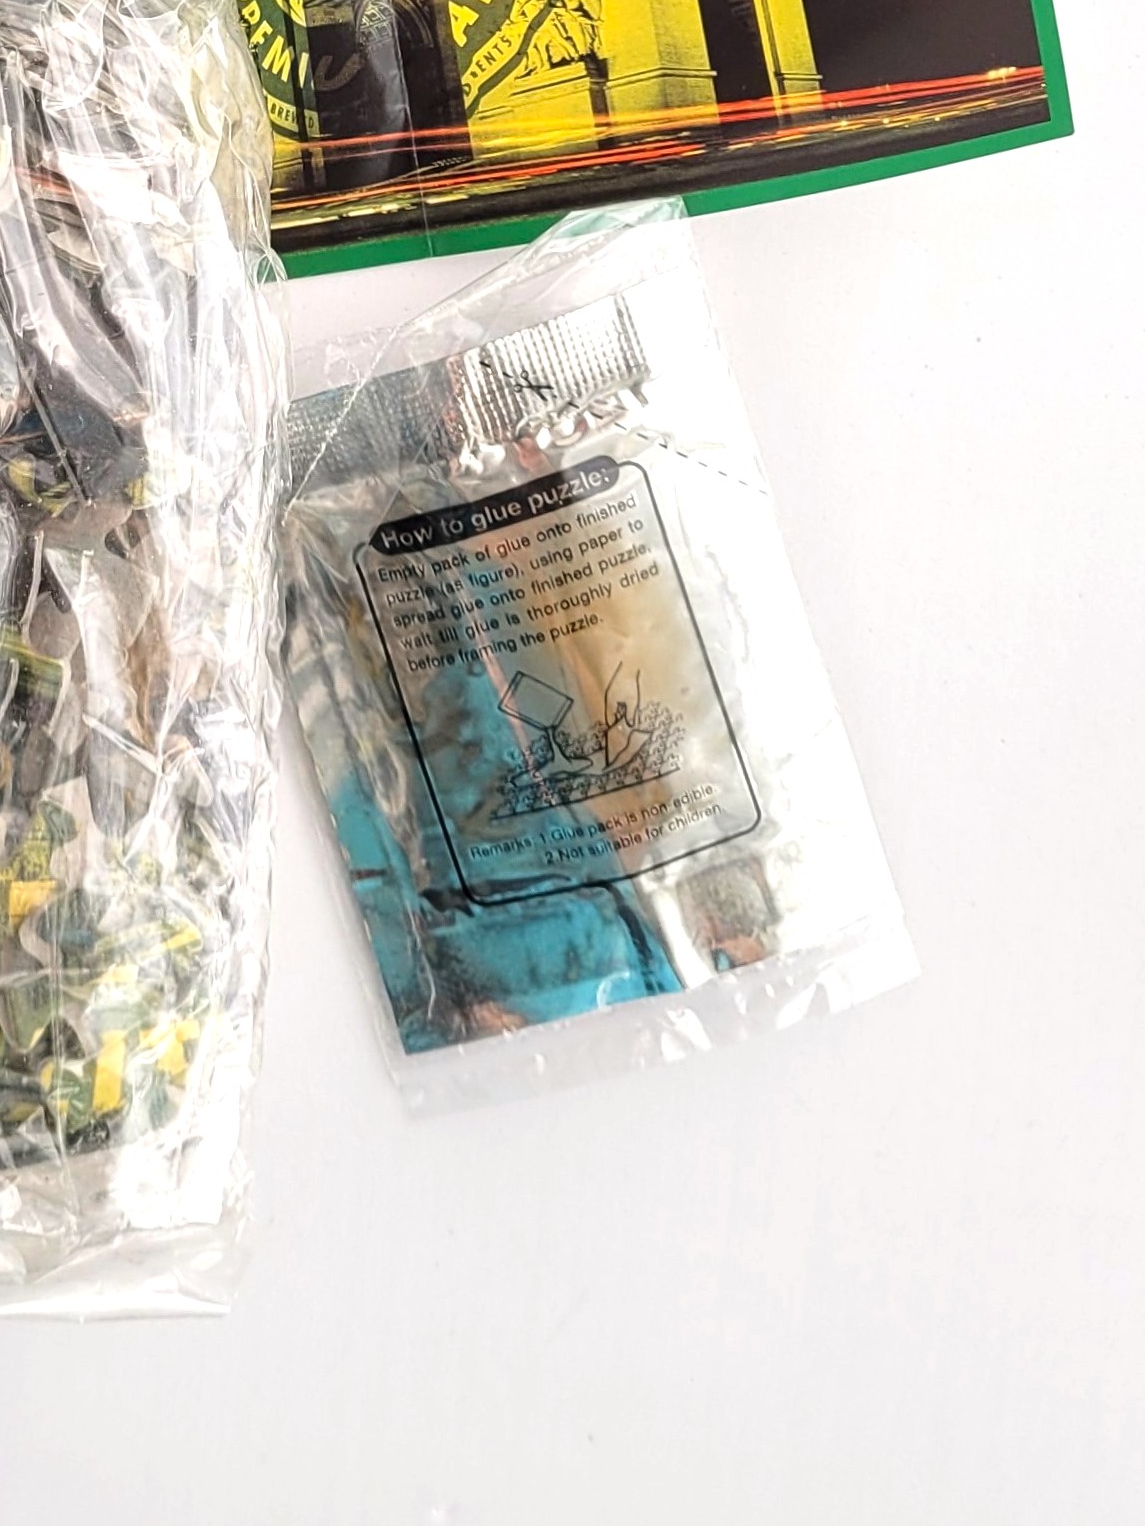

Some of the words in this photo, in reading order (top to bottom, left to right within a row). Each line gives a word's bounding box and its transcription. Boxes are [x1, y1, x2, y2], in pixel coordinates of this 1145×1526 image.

[377, 561, 427, 587] Empty
[430, 551, 471, 578] pack
[474, 541, 493, 563] of
[495, 535, 532, 560] glue
[535, 521, 573, 545] onto
[575, 494, 638, 529] finished
[379, 523, 435, 550] How
[439, 515, 464, 534] to
[469, 499, 523, 532] glue
[386, 583, 434, 608] puzzle
[528, 547, 575, 572] using
[578, 529, 624, 558] paper
[627, 517, 645, 533] to
[392, 604, 446, 631] spread
[450, 597, 485, 623] glue
[489, 587, 527, 607] onto
[530, 564, 594, 596] finished
[400, 631, 434, 652] wait
[439, 623, 461, 645] till
[464, 616, 501, 640] glue
[505, 609, 522, 627] is
[526, 579, 614, 623] thoroughly
[619, 560, 661, 590] dried
[406, 647, 456, 674] before
[457, 637, 519, 666] framing
[519, 626, 547, 646] the
[587, 815, 624, 838] pack
[625, 811, 639, 825] is
[588, 833, 644, 859] suitable
[644, 824, 666, 842] for
